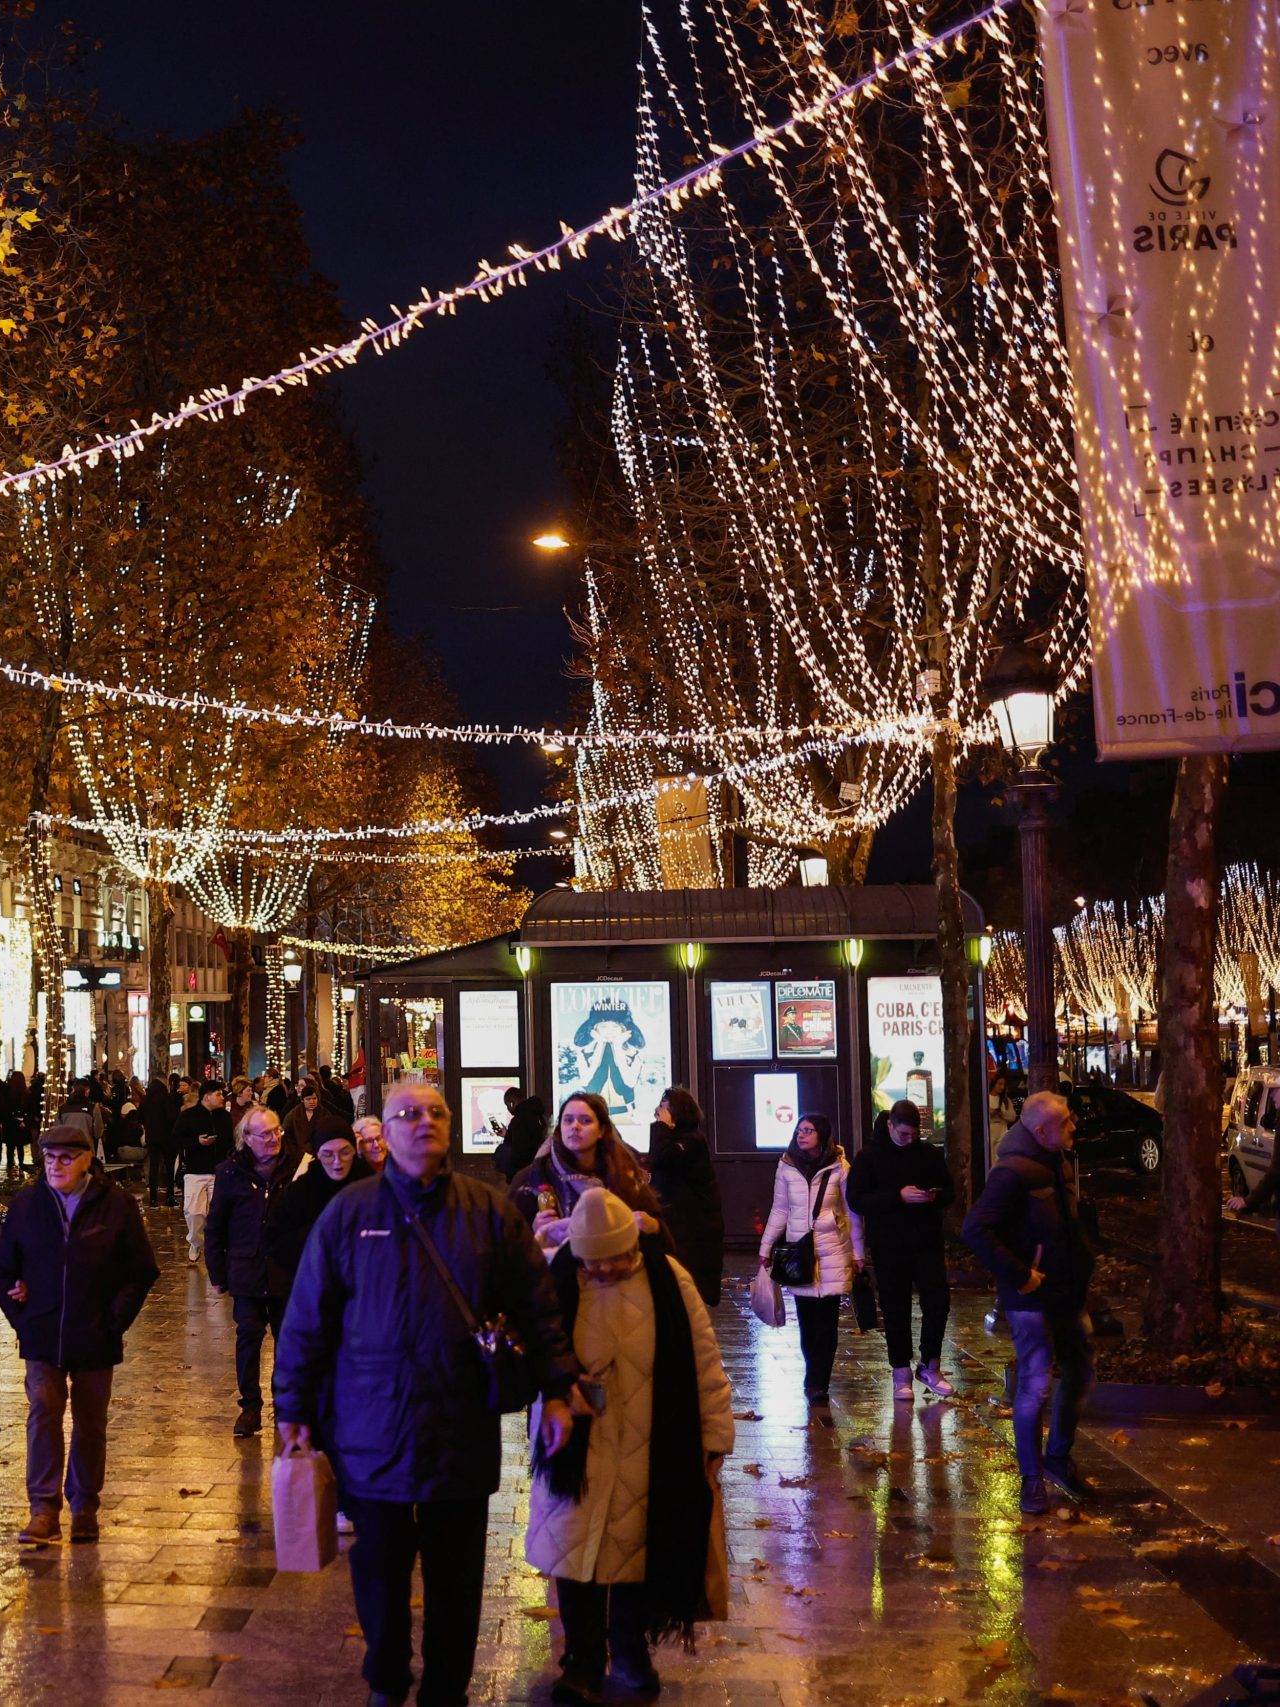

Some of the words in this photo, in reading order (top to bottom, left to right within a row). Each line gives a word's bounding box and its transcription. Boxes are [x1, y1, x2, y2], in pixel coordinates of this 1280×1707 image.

[778, 986, 833, 997] DIPLOMATIE
[593, 1003, 626, 1011] WINTER
[876, 1002, 919, 1019] CUBA,
